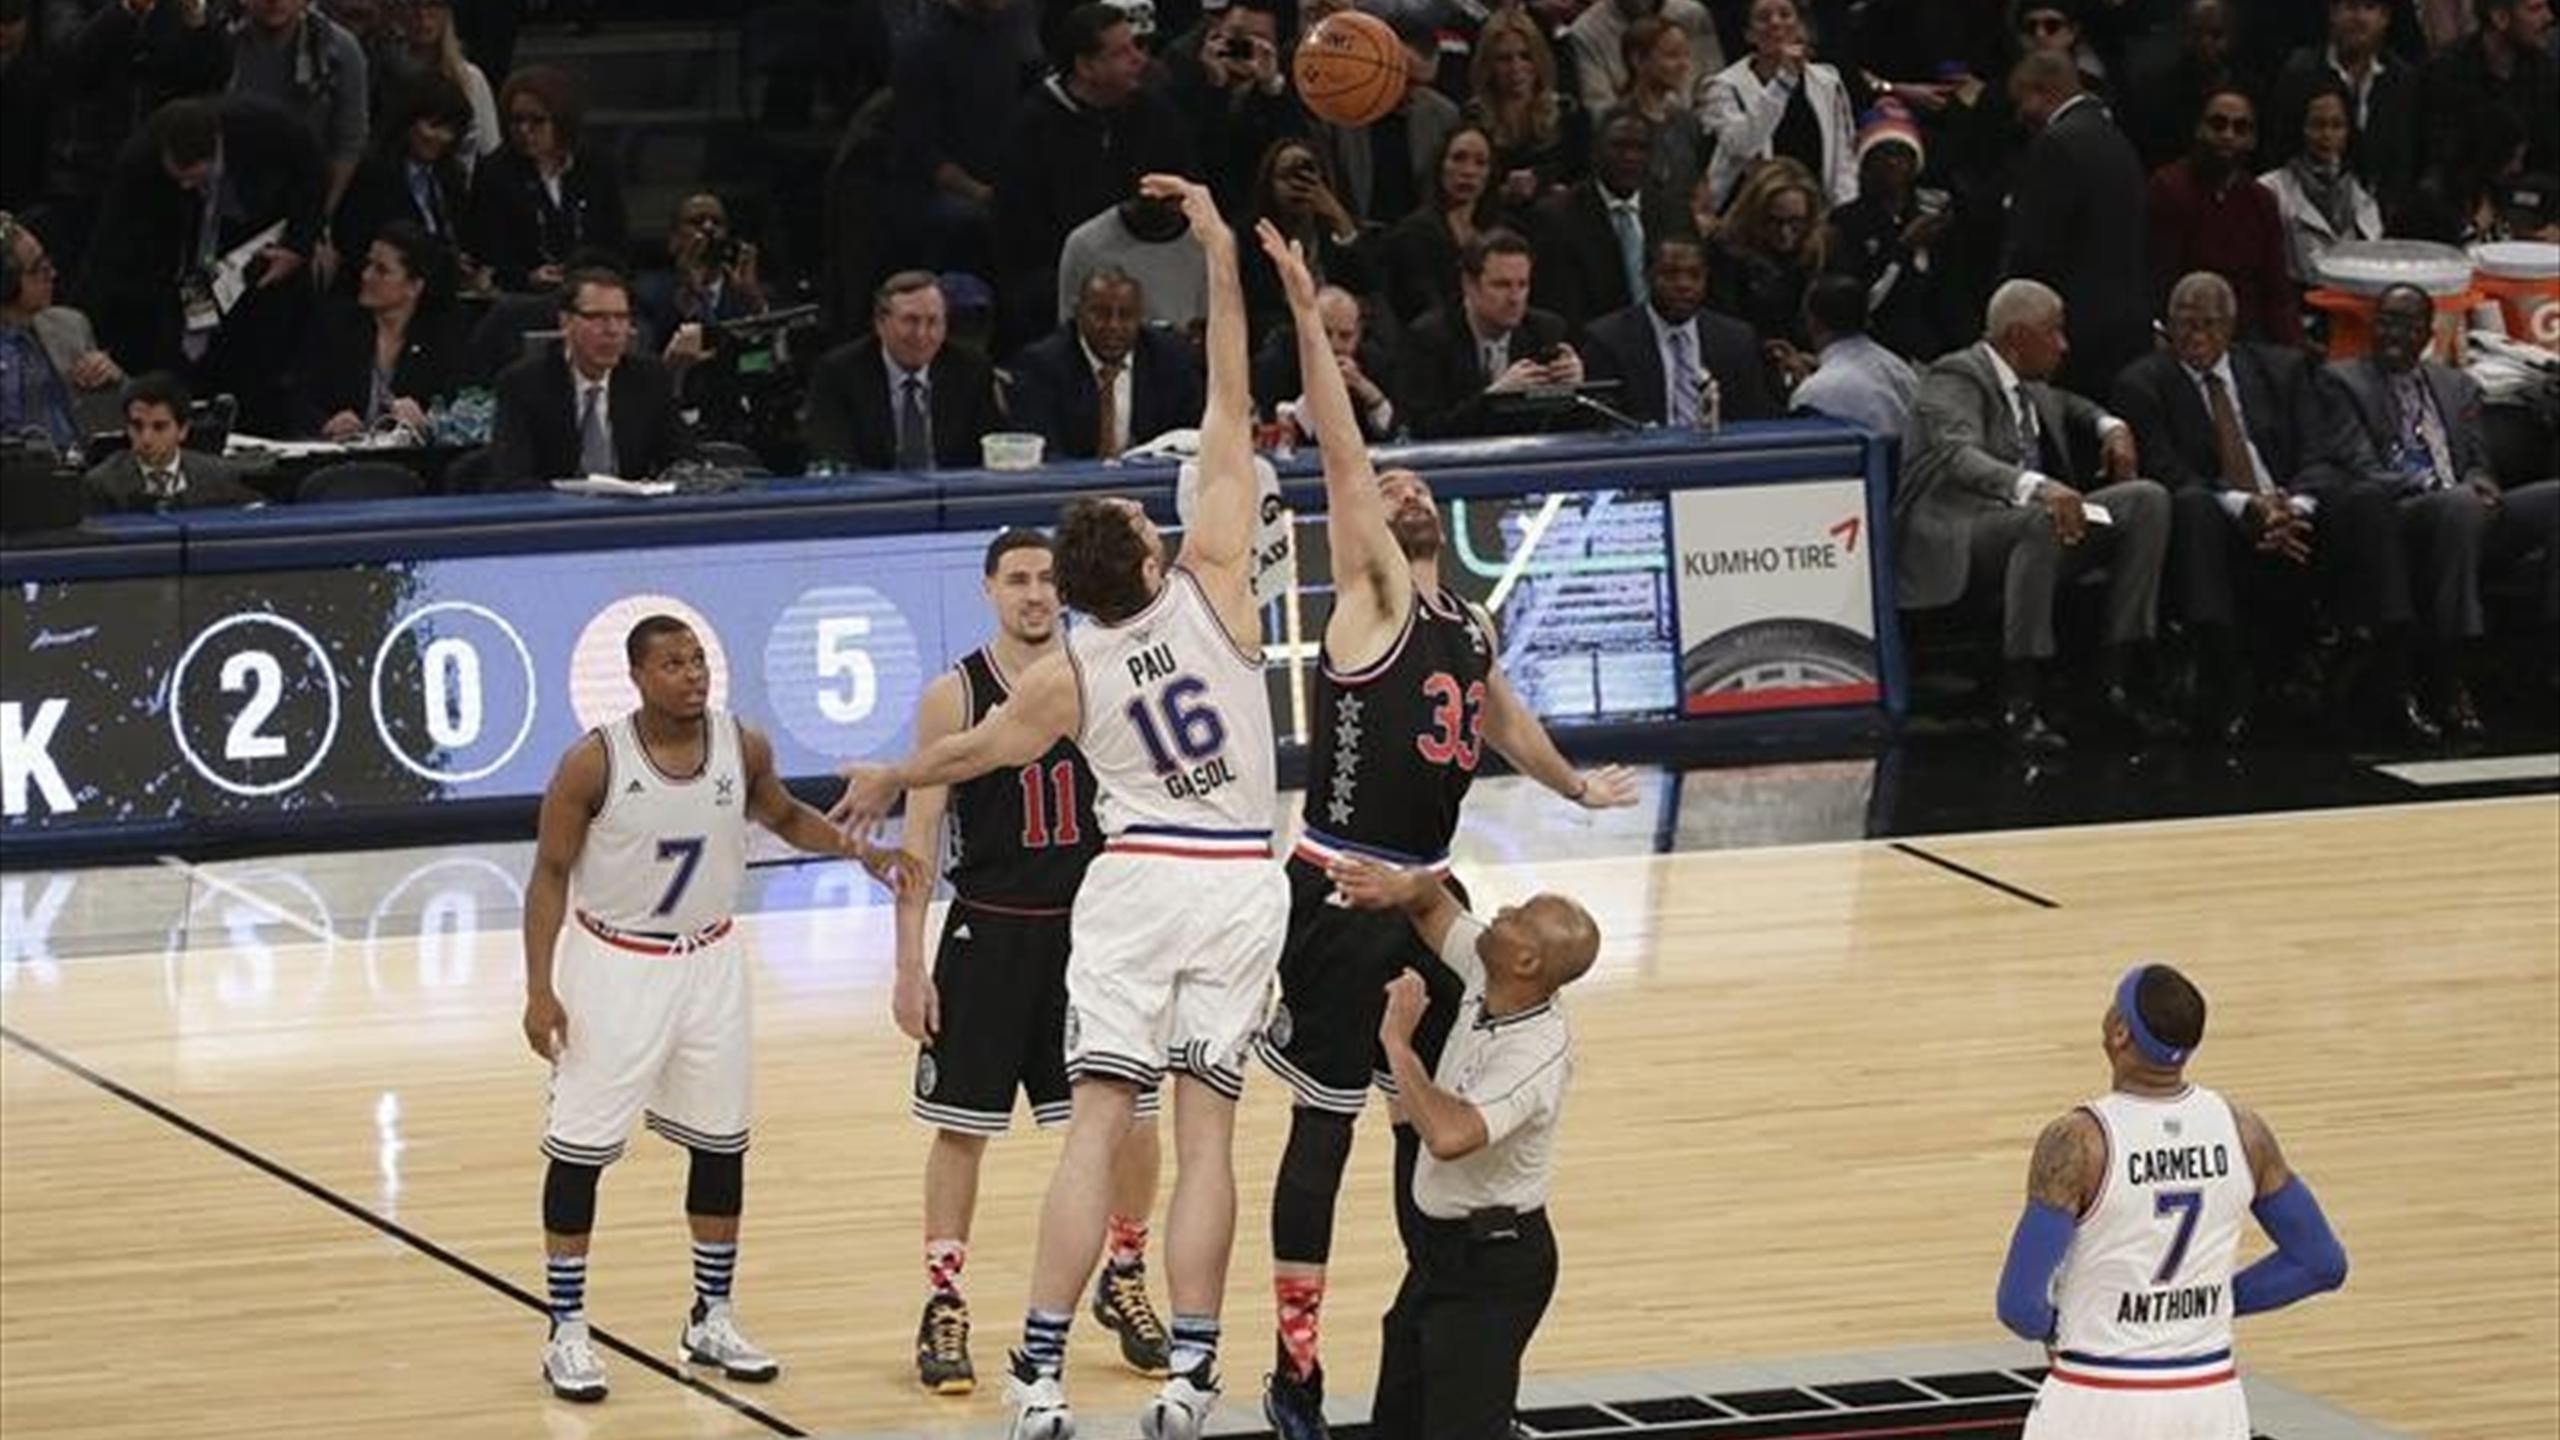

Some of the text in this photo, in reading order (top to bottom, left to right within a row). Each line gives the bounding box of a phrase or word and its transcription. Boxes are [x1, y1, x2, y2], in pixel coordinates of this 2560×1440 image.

[1684, 544, 1837, 577] KUMHO TIRE
[1127, 643, 1176, 687] PAU
[0, 617, 876, 815] K 2 0 5
[1129, 676, 1226, 777] 16
[1417, 671, 1486, 771] 33
[1021, 760, 1079, 847] 11
[1164, 757, 1237, 799] GASOL
[655, 837, 707, 918] 7
[2129, 1145, 2228, 1184] CARMELO
[2152, 1188, 2204, 1286] 7
[2117, 1285, 2222, 1323] ANTHONY
